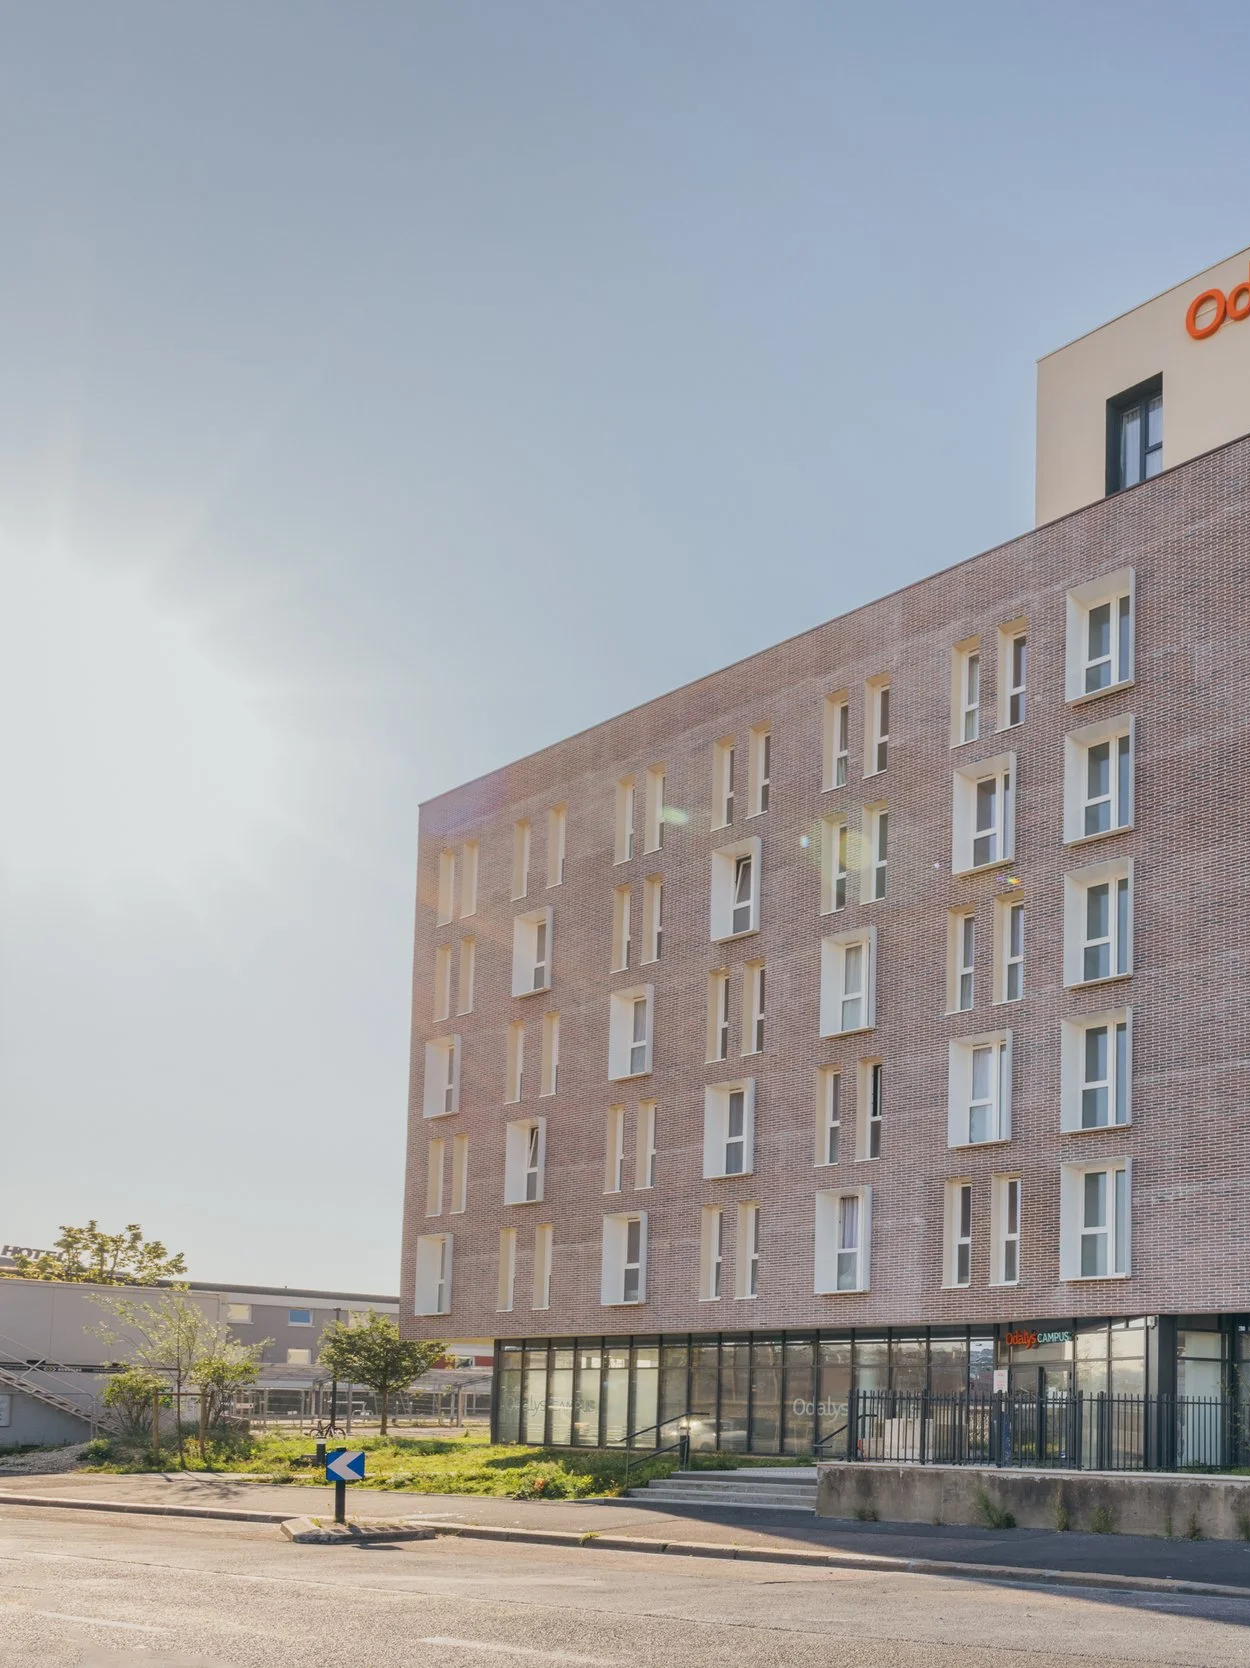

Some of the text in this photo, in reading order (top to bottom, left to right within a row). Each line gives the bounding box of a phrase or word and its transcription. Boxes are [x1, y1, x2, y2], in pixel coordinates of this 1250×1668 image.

[1005, 1328, 1070, 1349] Odalys CAMPUS
[792, 1396, 848, 1422] Odalys
